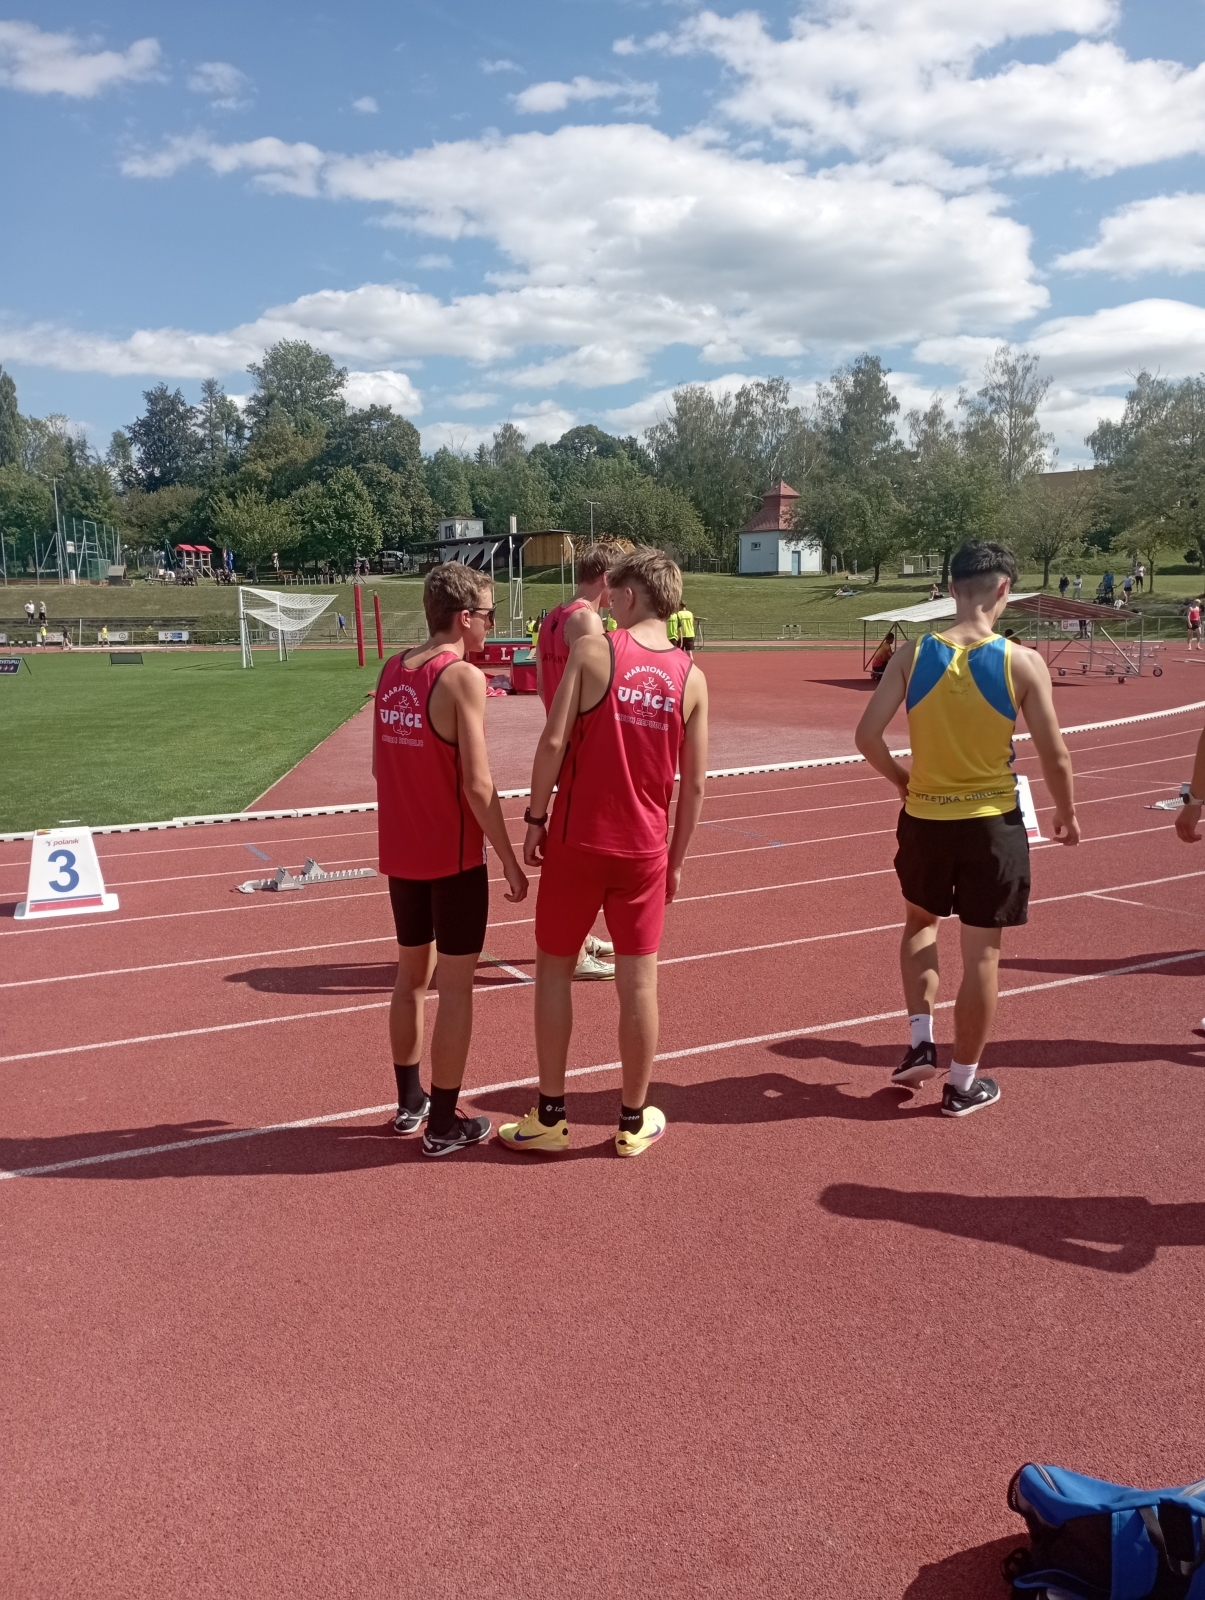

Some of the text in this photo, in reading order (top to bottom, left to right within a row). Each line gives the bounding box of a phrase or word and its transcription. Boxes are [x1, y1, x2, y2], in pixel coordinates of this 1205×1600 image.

[623, 665, 676, 691] MARATONSTAV
[53, 838, 79, 846] polanik
[48, 849, 79, 892] 3
